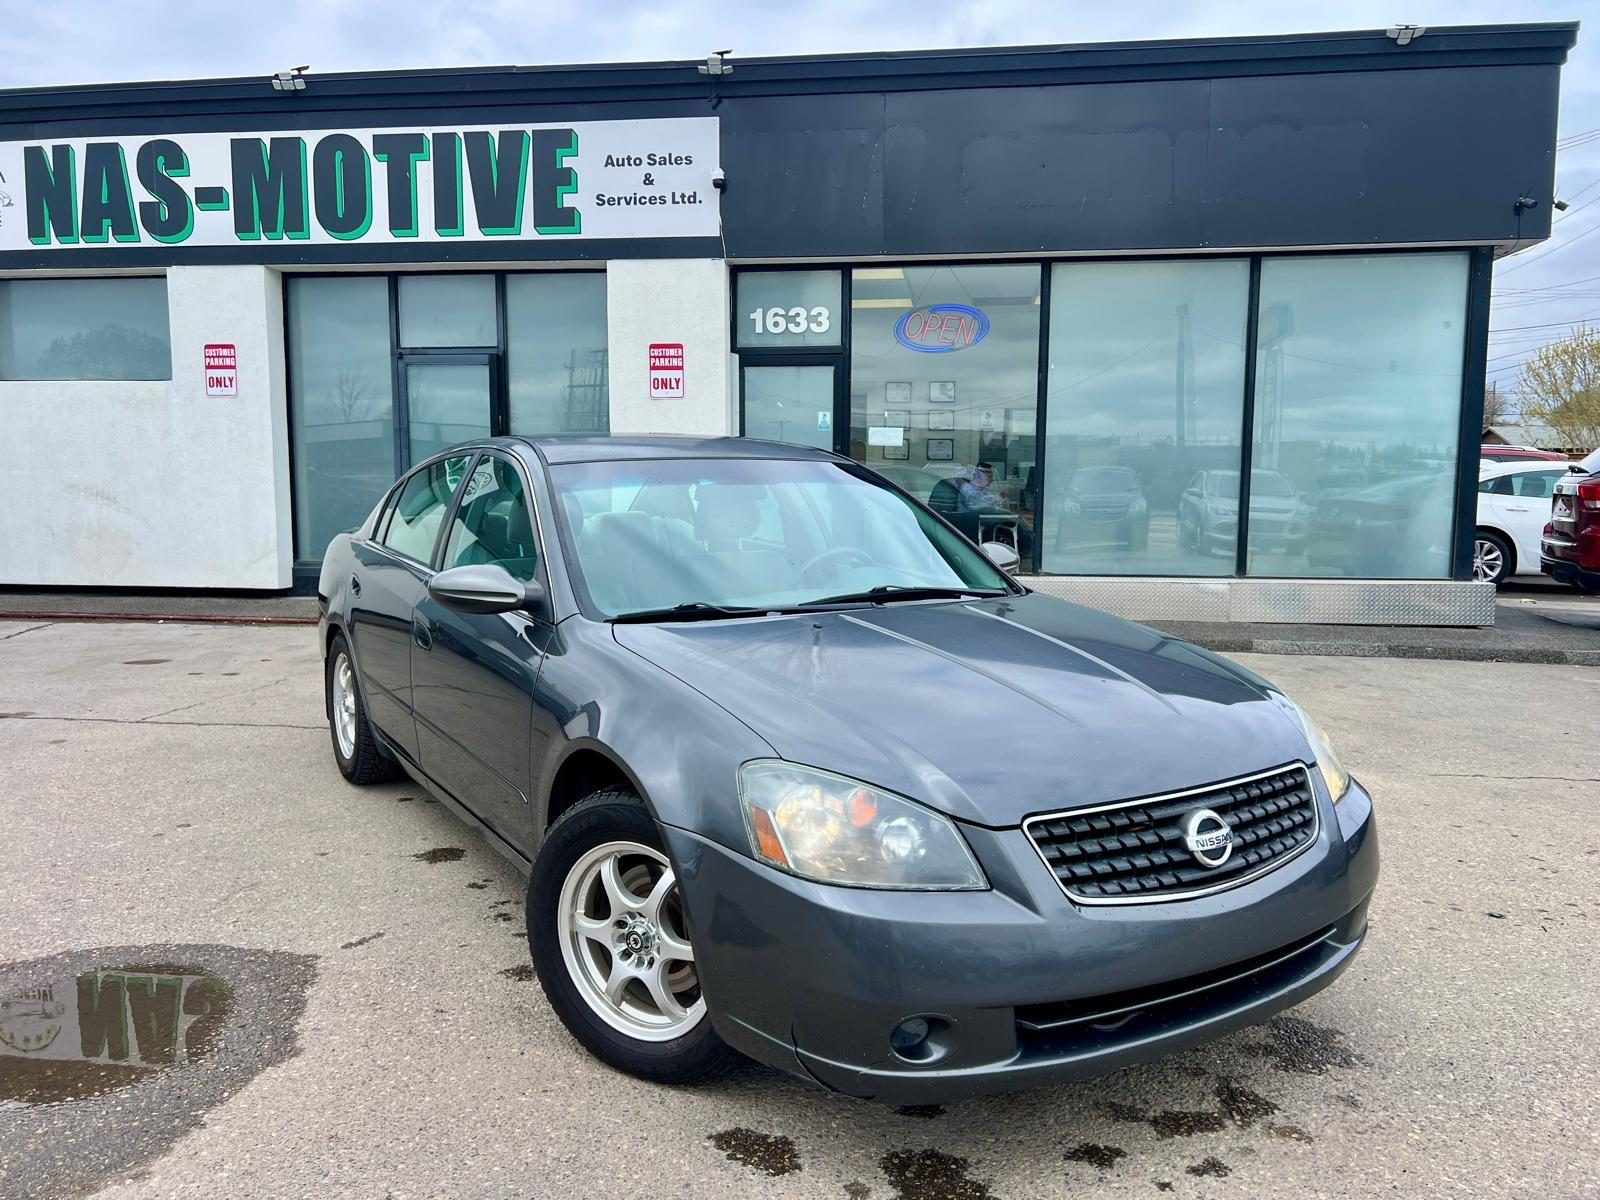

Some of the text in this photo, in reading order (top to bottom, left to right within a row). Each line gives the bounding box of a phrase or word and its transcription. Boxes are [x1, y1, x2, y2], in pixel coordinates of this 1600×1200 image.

[604, 153, 693, 168] Auto Sales
[643, 172, 655, 186] &
[24, 128, 581, 244] NAS-MOTIVE
[595, 191, 703, 207] Services Ltd.
[749, 306, 830, 334] 1633
[902, 310, 978, 345] OPEN
[205, 348, 235, 357] CUSTOMER
[650, 348, 682, 357] CUSTOMER
[205, 357, 236, 367] PARKING
[650, 357, 683, 367] PARKING
[208, 376, 234, 388] ONLY
[652, 377, 681, 390] ONLY
